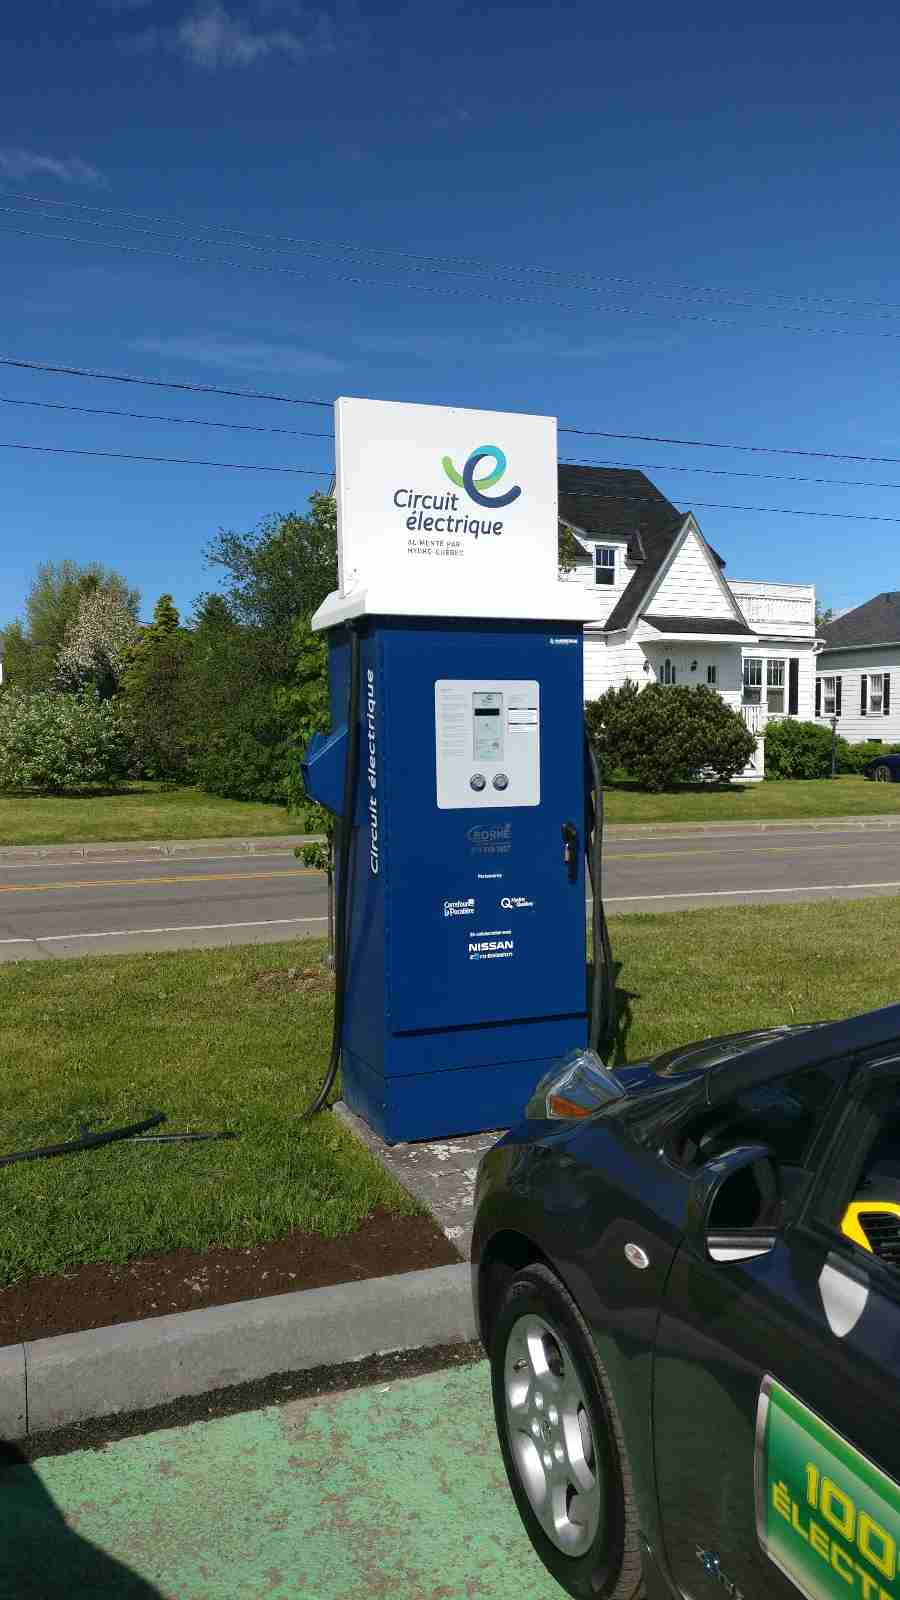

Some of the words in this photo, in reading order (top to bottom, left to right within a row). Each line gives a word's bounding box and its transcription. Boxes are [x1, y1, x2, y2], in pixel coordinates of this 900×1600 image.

[393, 488, 459, 511] Circuit
[406, 510, 504, 540] électrique
[367, 669, 377, 789] électrique
[368, 797, 379, 874] Circuit
[468, 940, 514, 953] NISSAN
